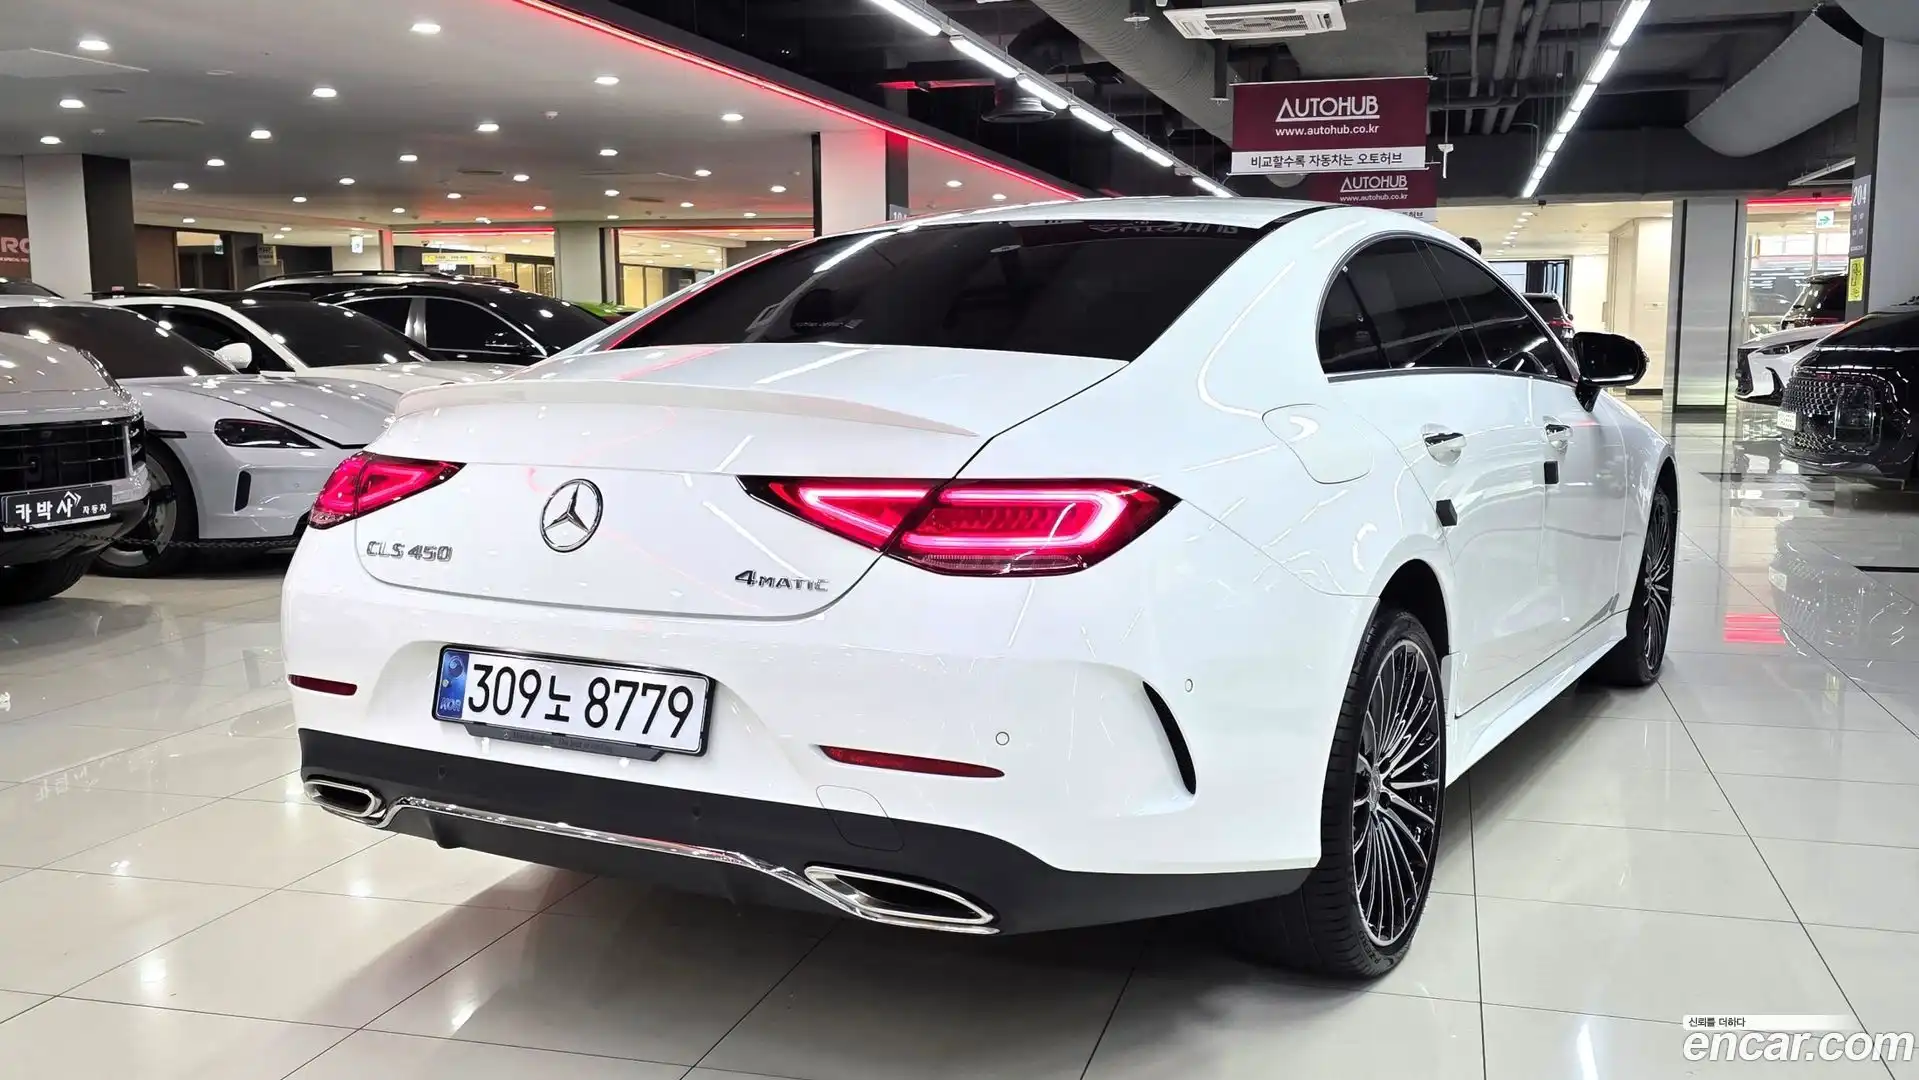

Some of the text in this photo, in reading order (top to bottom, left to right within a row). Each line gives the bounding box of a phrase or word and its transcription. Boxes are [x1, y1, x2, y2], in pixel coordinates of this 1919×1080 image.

[1275, 96, 1380, 122] AUTOHUB
[1275, 124, 1379, 137] www.autohub.co.kr
[1251, 152, 1403, 168] 비교할수록 자동차는 오토허브
[1340, 175, 1408, 193] AUTOHUB
[1340, 193, 1408, 203] www.autohub.co.kr
[366, 540, 452, 563] CLS 450
[734, 569, 829, 592] 4MATIC
[440, 697, 462, 712] KOR
[584, 676, 694, 739] 8779
